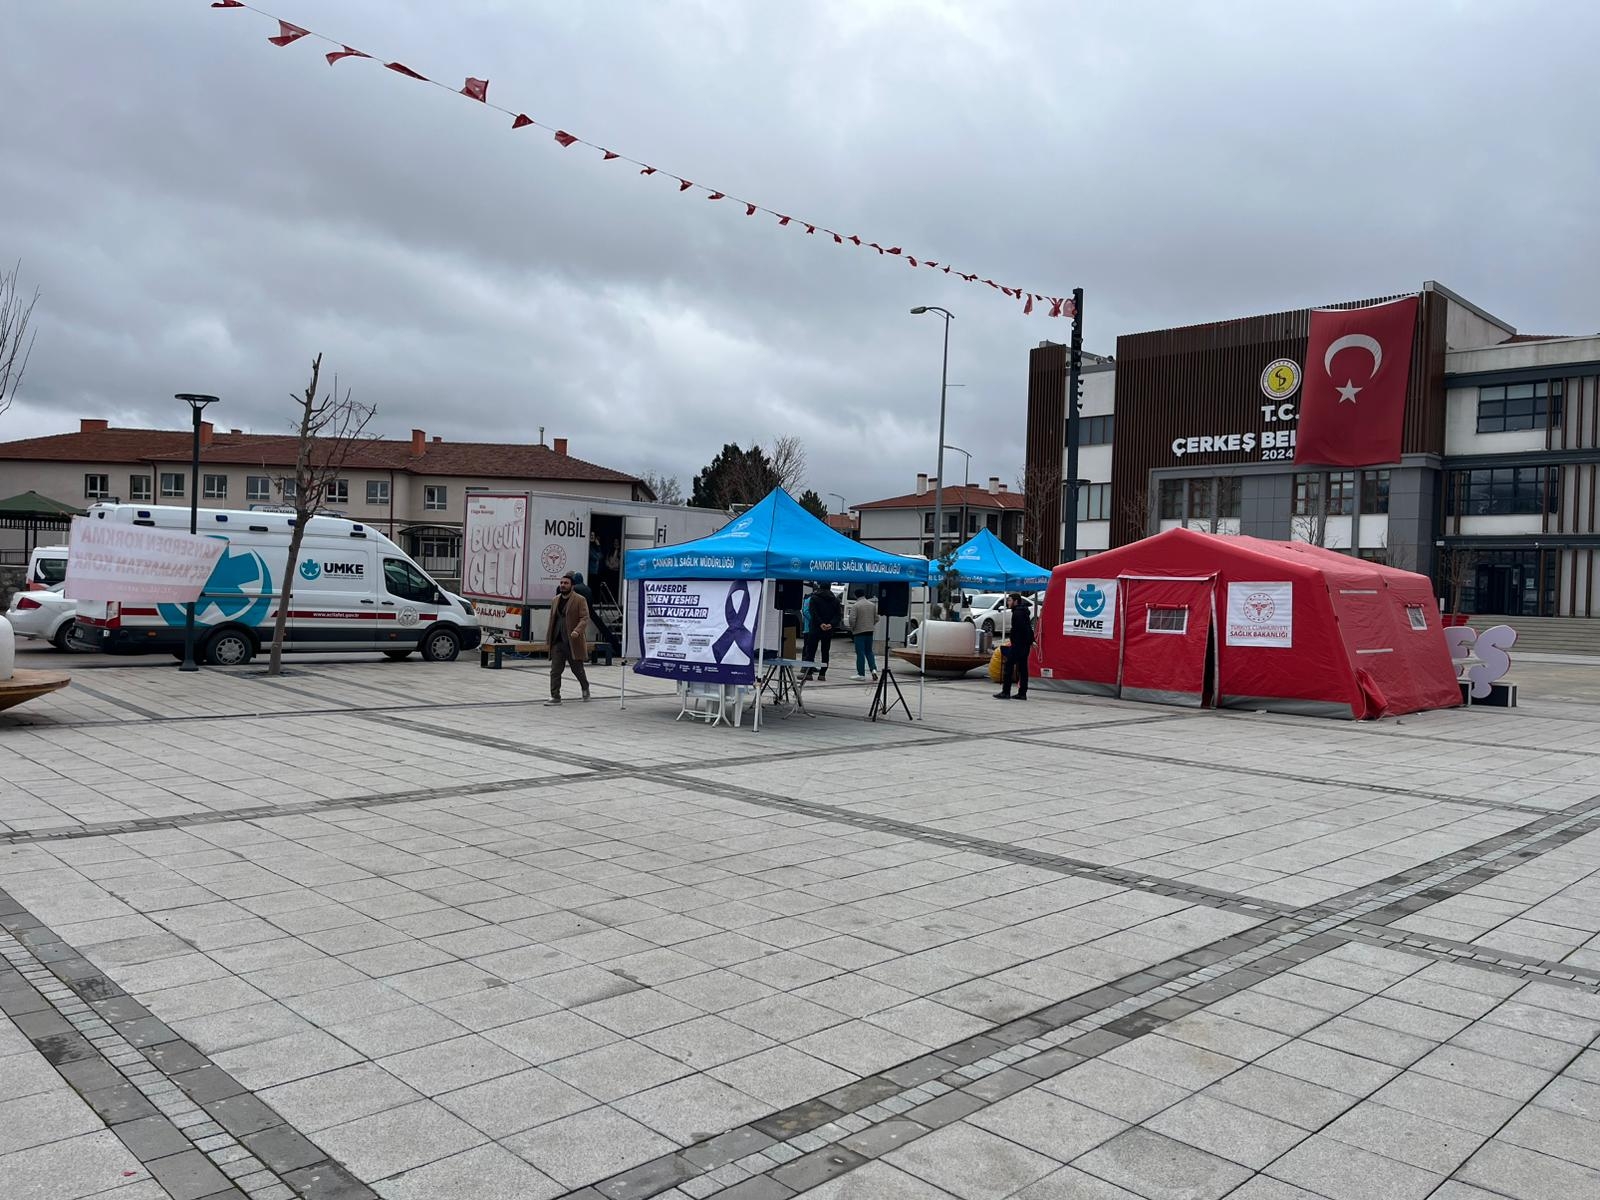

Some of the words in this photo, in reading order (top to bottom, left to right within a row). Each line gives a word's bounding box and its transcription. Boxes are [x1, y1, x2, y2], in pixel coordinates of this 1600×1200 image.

[1261, 403, 1299, 422] T.C.
[1172, 432, 1256, 457] ÇERKEŞ
[1261, 449, 1293, 460] 2024
[545, 517, 586, 538] MOBİL
[470, 522, 521, 553] BUGÜN
[324, 562, 364, 574] UMKE
[652, 558, 673, 569] ÇANKIRI
[680, 555, 698, 567] SAĞLIK
[700, 556, 735, 569] MÜDÜRLÜĞÜ
[809, 559, 835, 571] ÇANKIRI
[842, 559, 864, 572] SAĞLIK
[865, 561, 901, 574] MÜDÜRLÜĞÜ
[646, 584, 687, 593] KANSERDE
[667, 607, 708, 618] KURTARIR
[1073, 618, 1104, 629] UMKE
[1253, 630, 1288, 638] BAKANLIĞI
